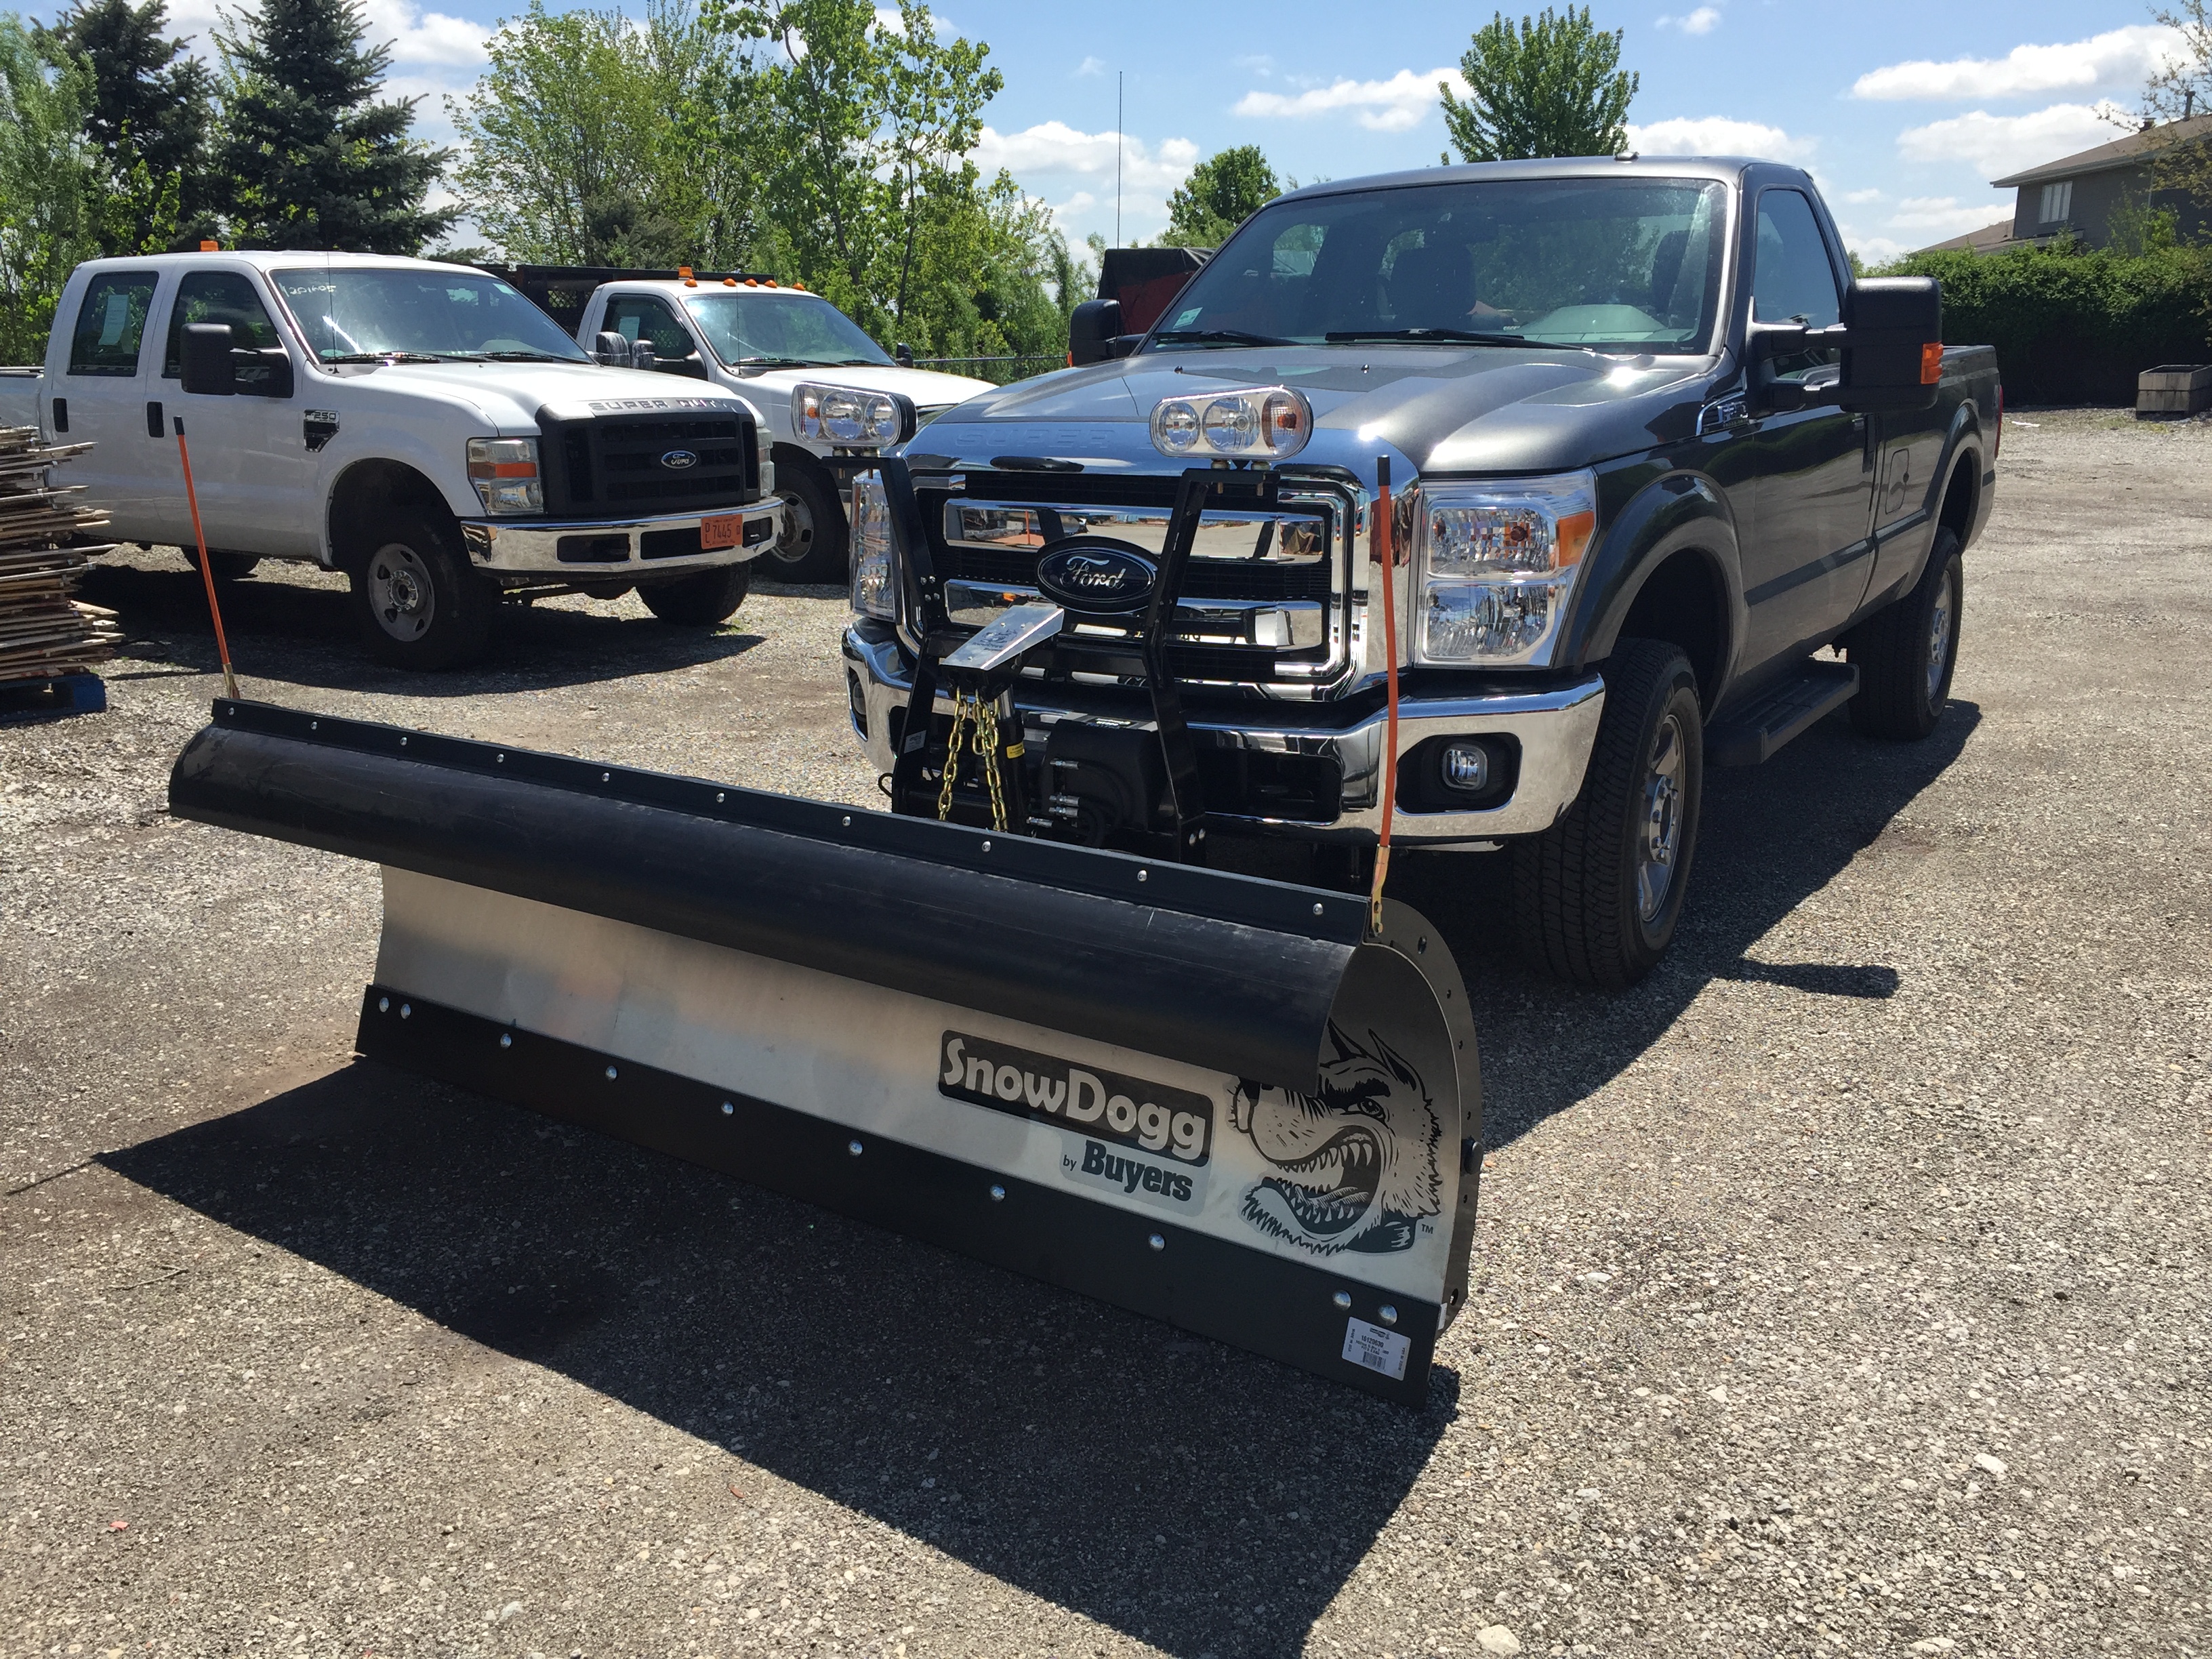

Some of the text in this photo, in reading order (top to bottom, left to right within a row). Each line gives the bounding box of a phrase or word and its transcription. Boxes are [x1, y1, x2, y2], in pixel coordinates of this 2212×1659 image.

[588, 399, 670, 411] SUPER
[954, 428, 1115, 449] SUPER
[670, 453, 690, 466] Ford
[1059, 556, 1127, 590] Ford
[943, 1038, 1206, 1161] SnowDogg
[1063, 1140, 1193, 1202] by Buyers
[1421, 1223, 1434, 1235] TM
